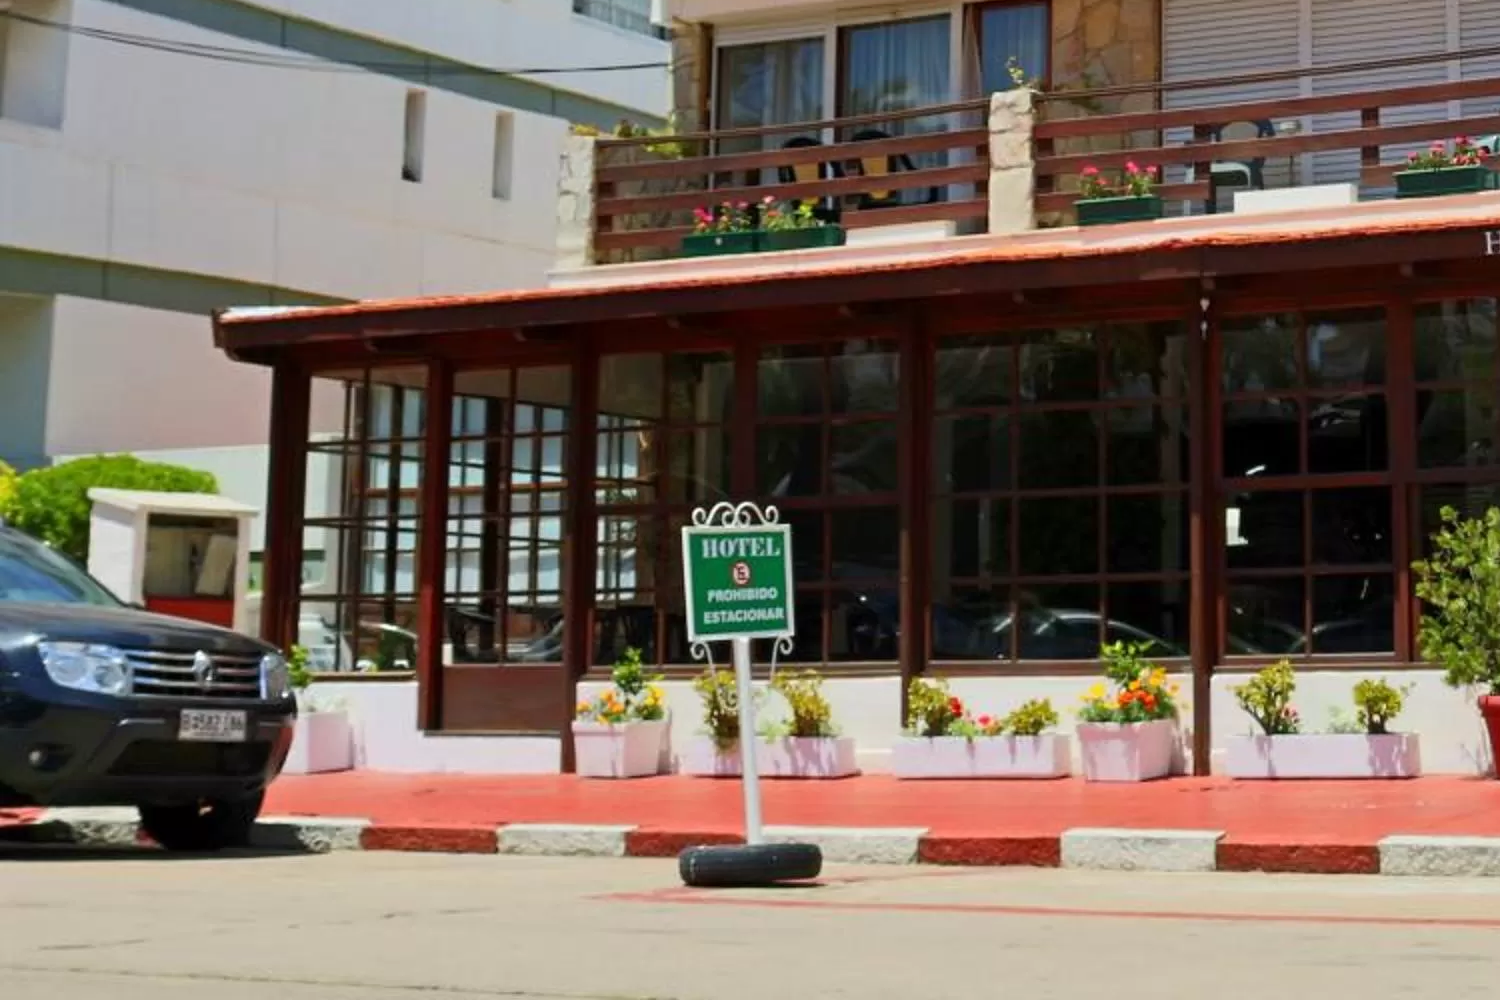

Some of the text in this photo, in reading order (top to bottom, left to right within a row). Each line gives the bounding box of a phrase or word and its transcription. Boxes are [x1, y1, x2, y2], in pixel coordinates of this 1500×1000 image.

[703, 537, 780, 558] HOTEL
[707, 588, 777, 602] PROHIBIDO
[703, 607, 784, 624] ESTACIONAR
